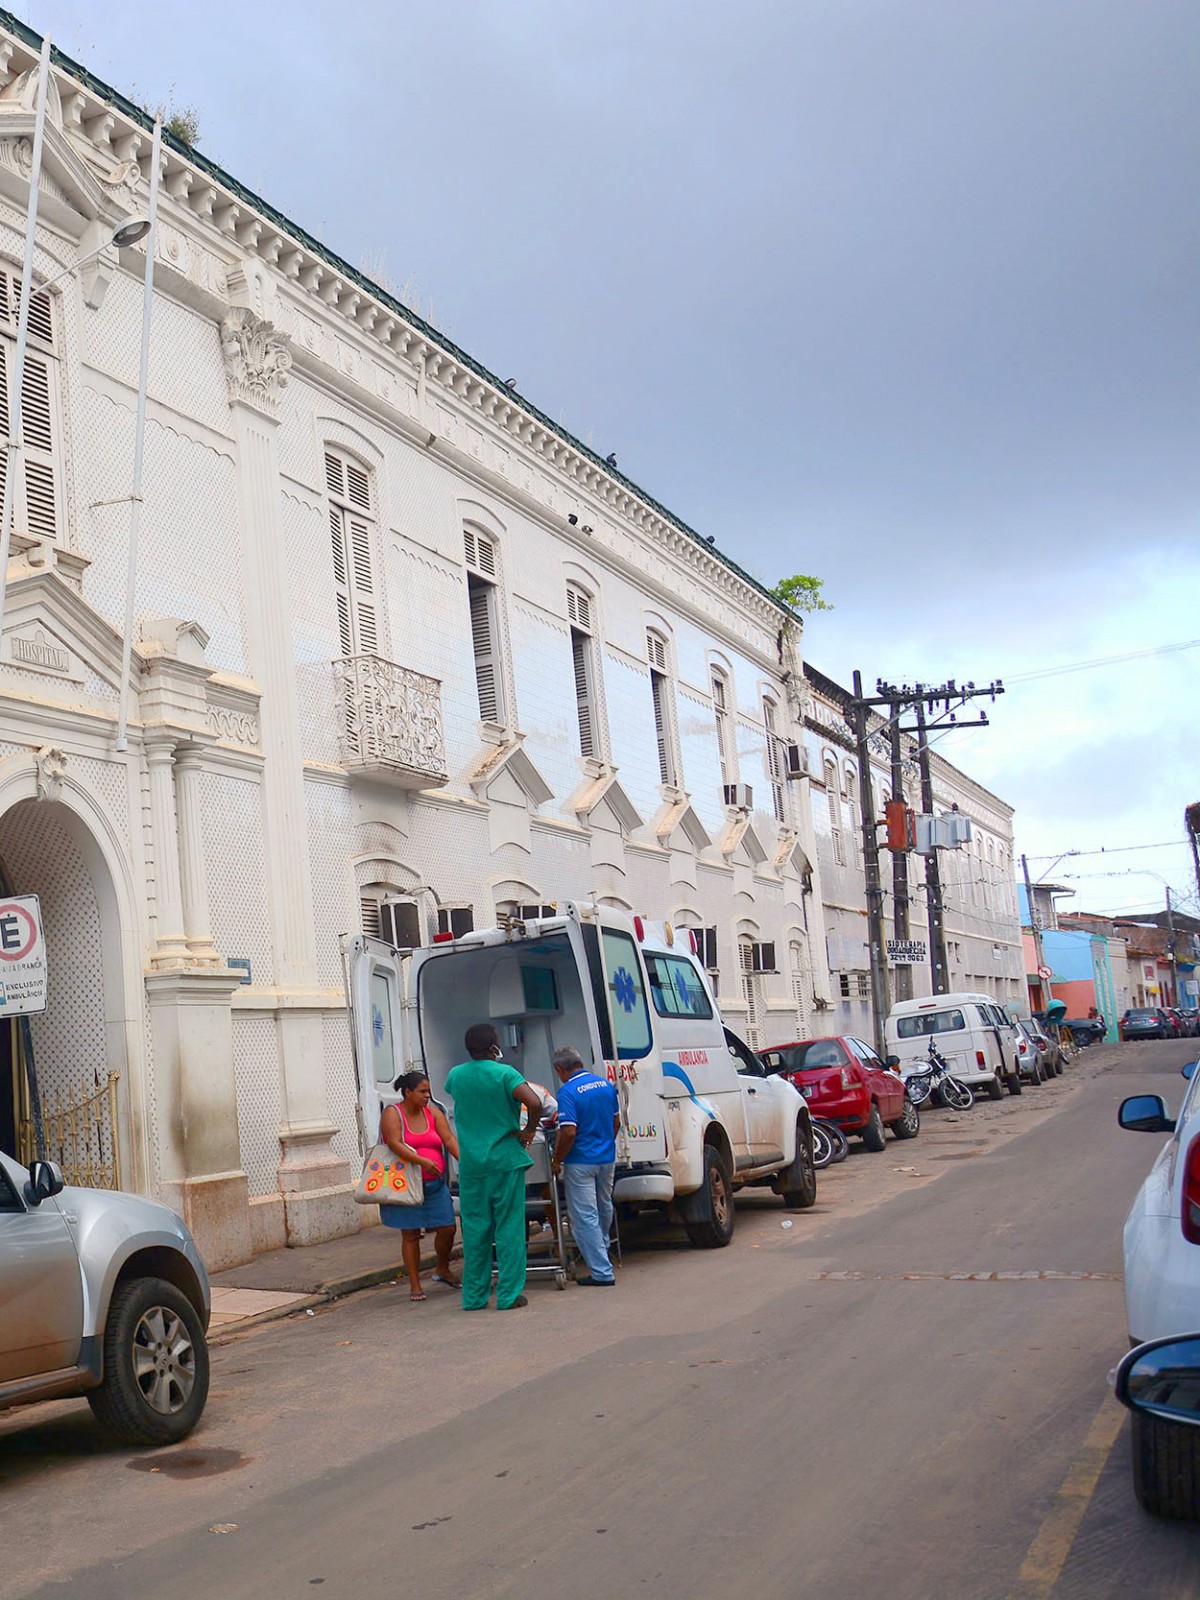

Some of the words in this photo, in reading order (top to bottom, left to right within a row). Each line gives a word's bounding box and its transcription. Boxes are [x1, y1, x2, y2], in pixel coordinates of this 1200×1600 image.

[16, 640, 63, 668] HOSPITAL
[0, 916, 21, 950] E
[577, 1080, 608, 1094] CONDUTOR
